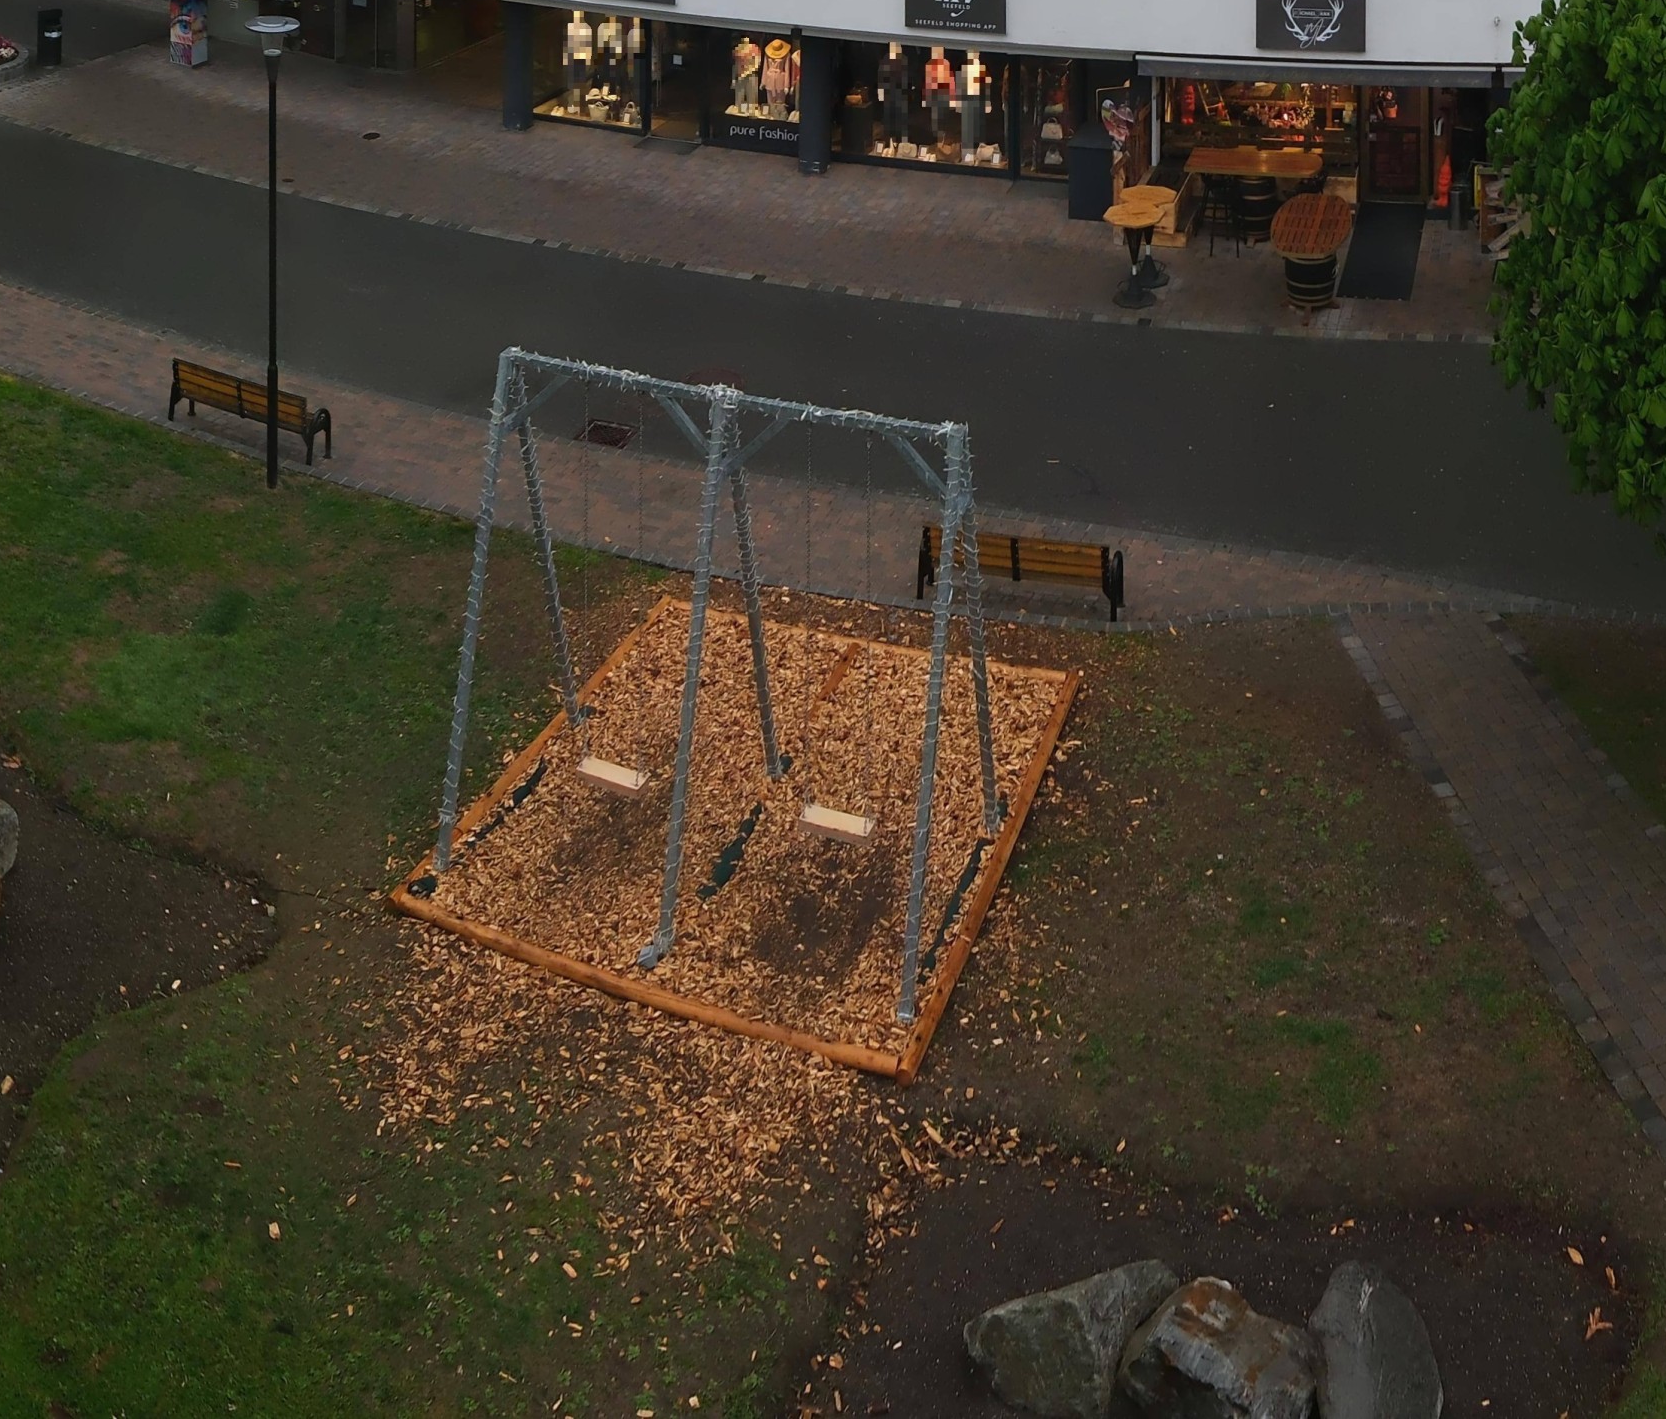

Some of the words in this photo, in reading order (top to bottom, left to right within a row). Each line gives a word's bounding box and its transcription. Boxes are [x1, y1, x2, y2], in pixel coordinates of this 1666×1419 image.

[942, 2, 971, 10] SEEFELD
[915, 18, 944, 27] SEEFELD
[946, 20, 981, 29] SHOPPING
[729, 125, 756, 137] pure
